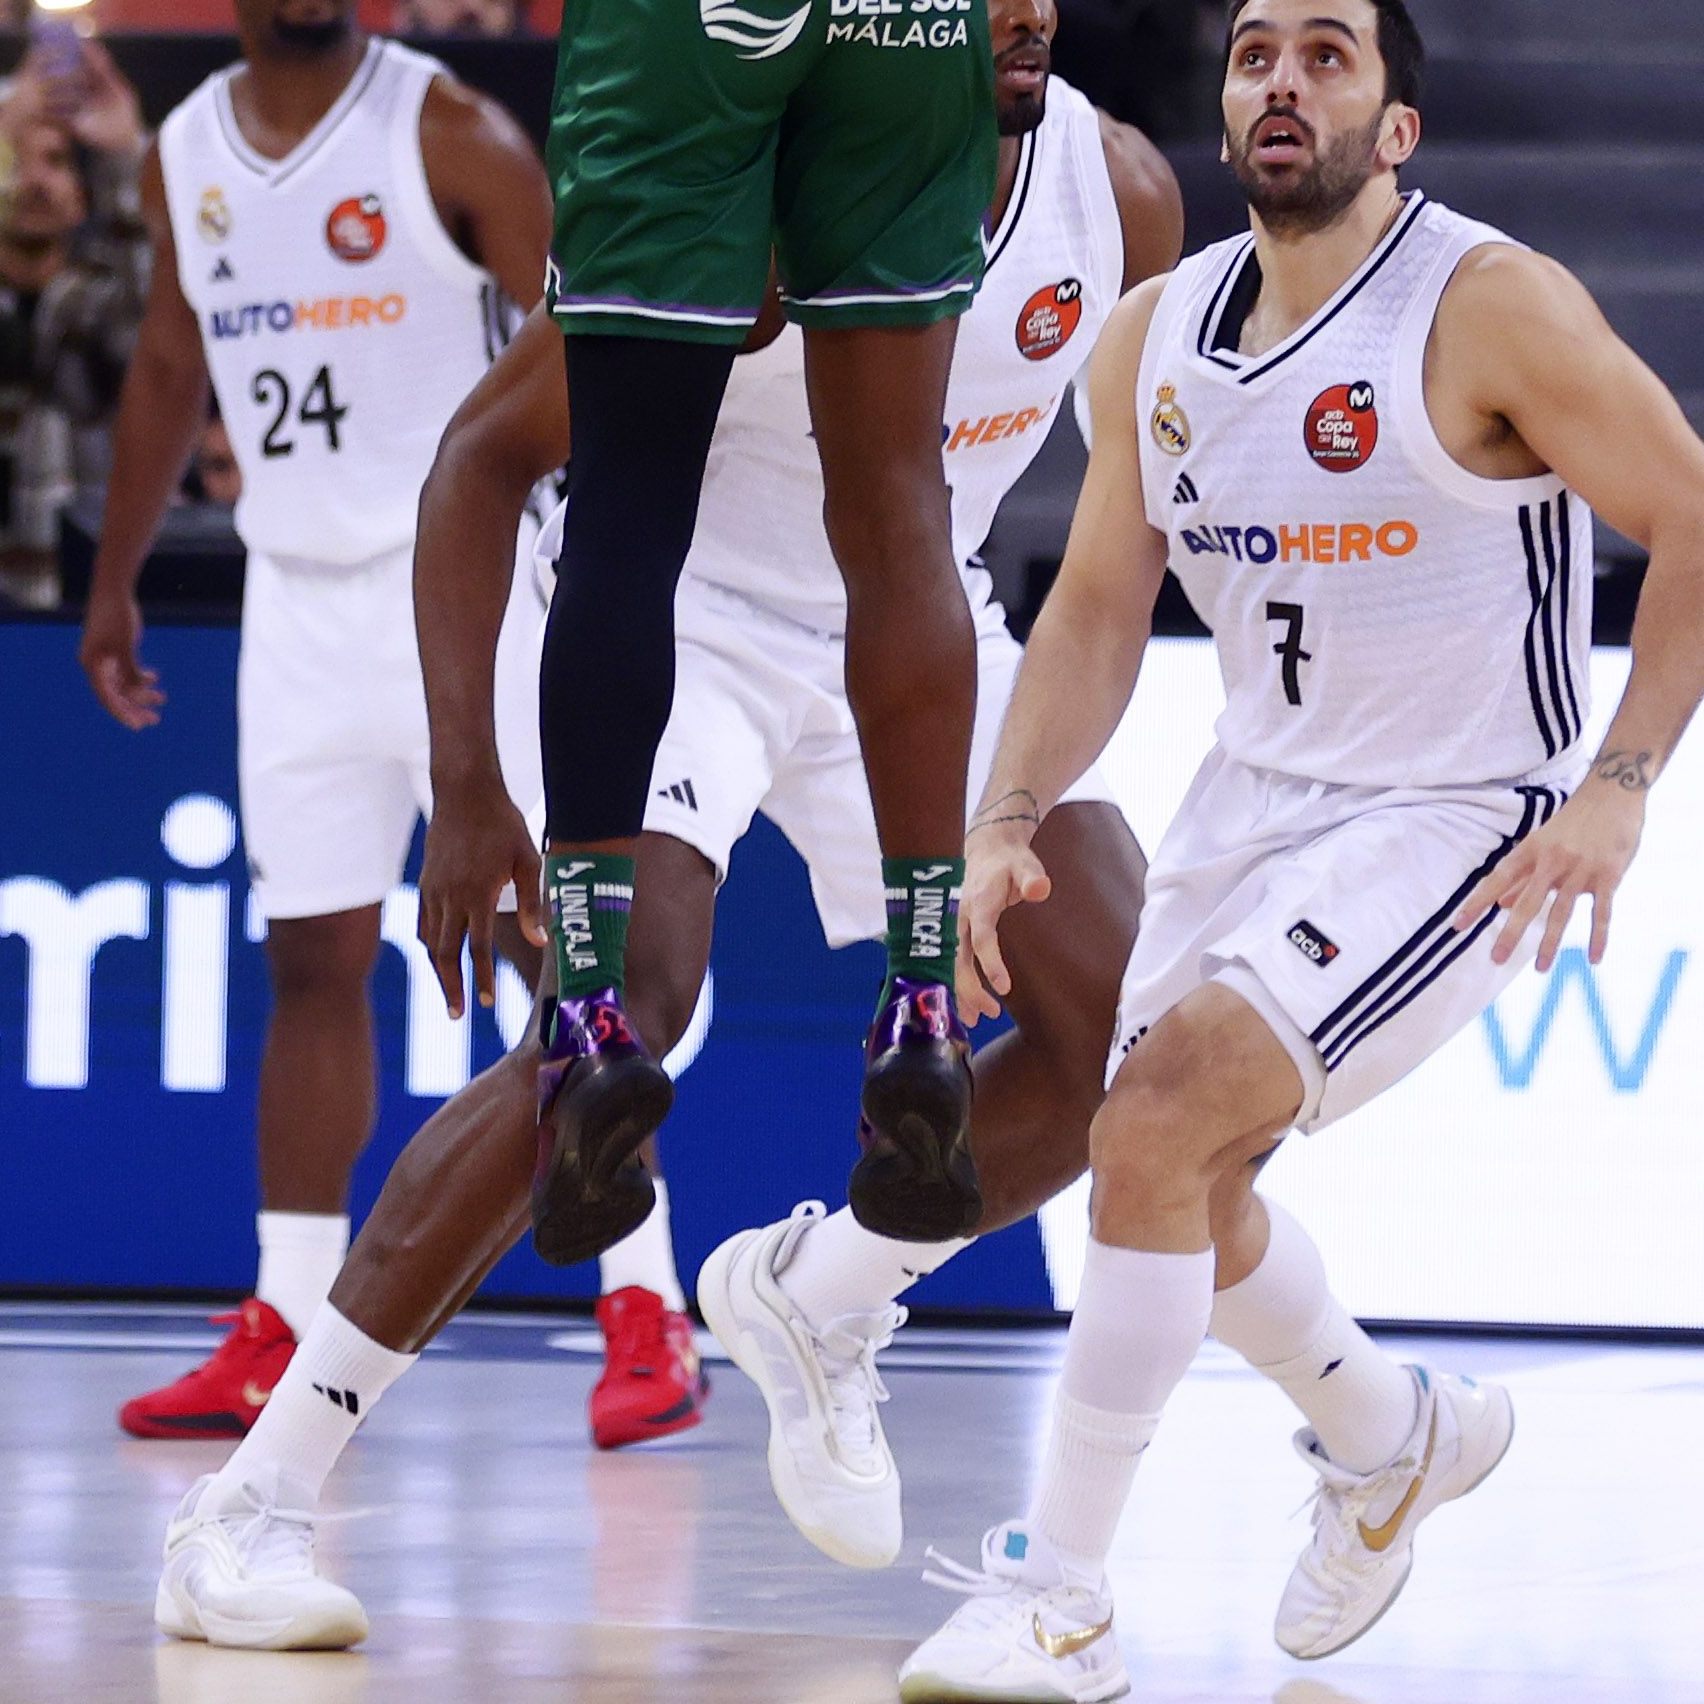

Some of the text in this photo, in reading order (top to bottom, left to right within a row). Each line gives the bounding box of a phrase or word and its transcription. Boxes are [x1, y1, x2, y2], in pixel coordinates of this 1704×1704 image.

[825, 16, 968, 49] MÁLAGA
[251, 362, 349, 459] 24
[1316, 419, 1353, 436] Copa
[1332, 434, 1359, 451] Rey
[1180, 520, 1418, 564] AUTOHERO
[1266, 601, 1312, 706] 7
[559, 883, 599, 972] UNICAJA
[1290, 928, 1323, 961] acb
